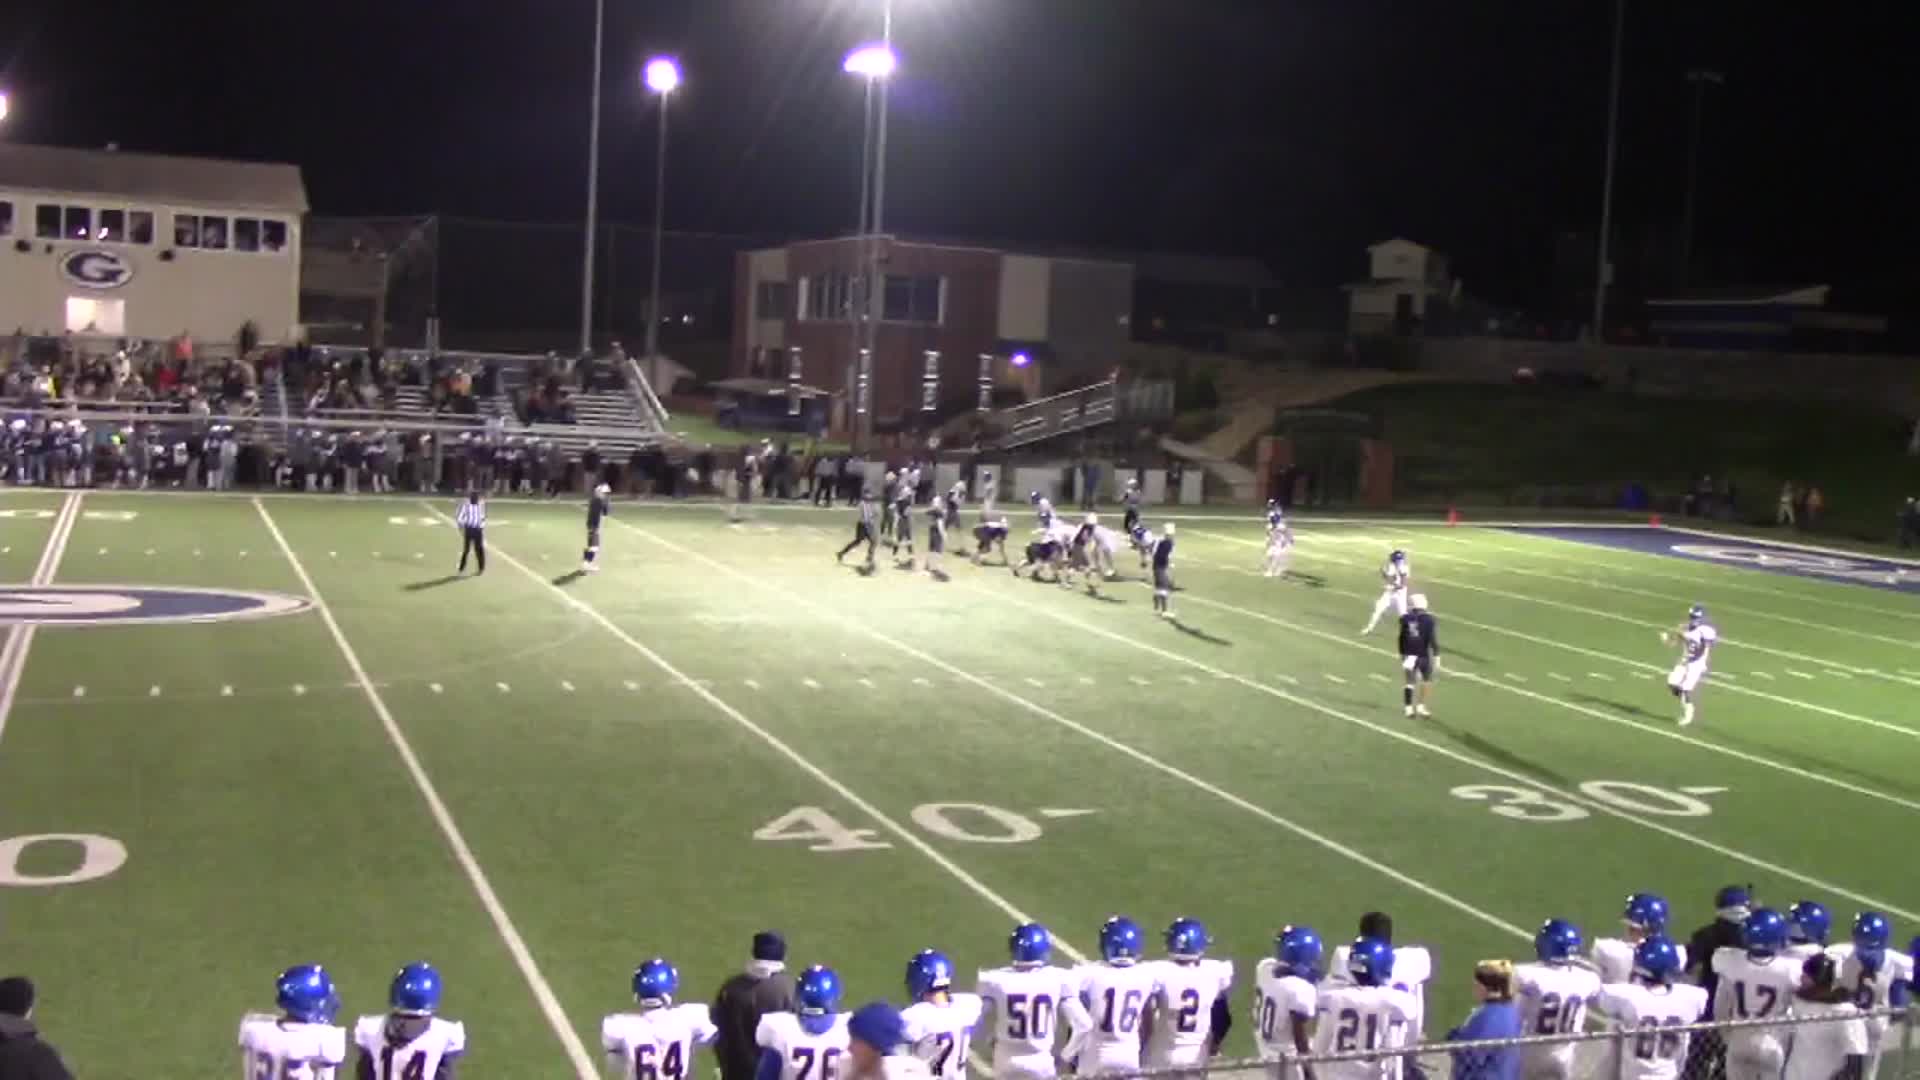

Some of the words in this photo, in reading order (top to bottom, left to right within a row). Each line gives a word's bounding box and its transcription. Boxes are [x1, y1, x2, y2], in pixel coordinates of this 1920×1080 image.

[1007, 993, 1053, 1039] 50
[1101, 987, 1142, 1033] 16
[1177, 988, 1200, 1032] 2
[1337, 1007, 1377, 1060] 21
